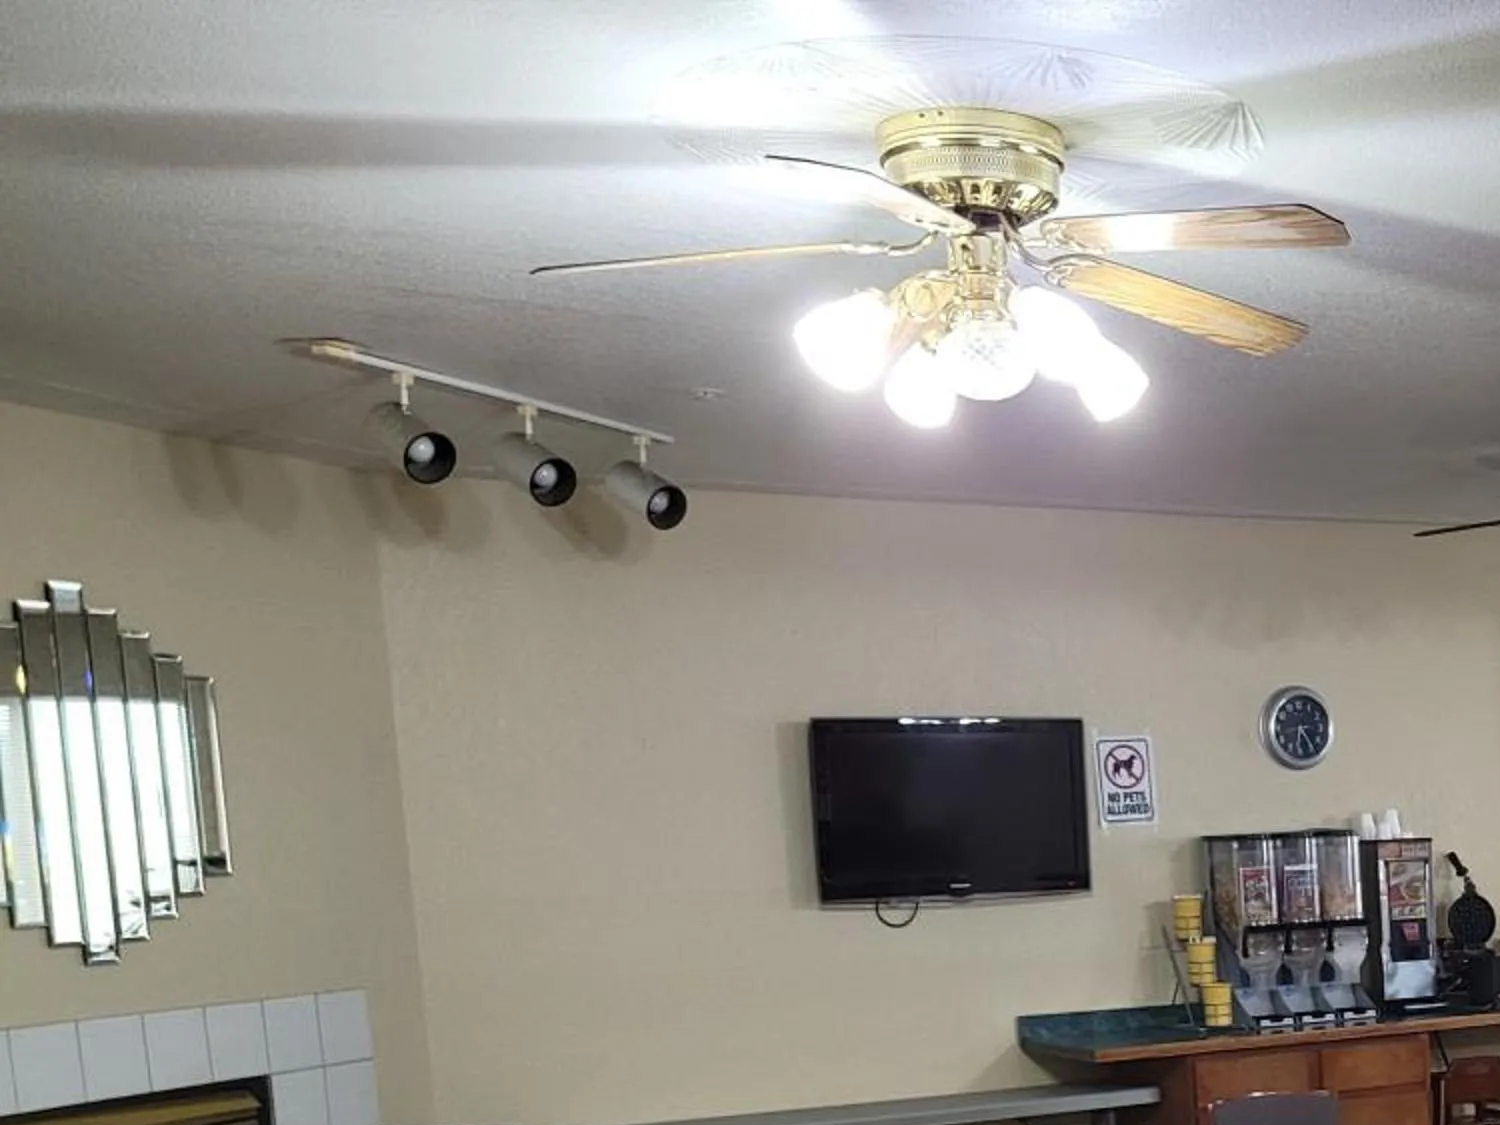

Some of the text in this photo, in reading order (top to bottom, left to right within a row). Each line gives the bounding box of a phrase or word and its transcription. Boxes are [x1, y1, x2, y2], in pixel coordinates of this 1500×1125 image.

[1108, 791, 1147, 802] NO PETS
[1107, 803, 1150, 815] ALLOWED
